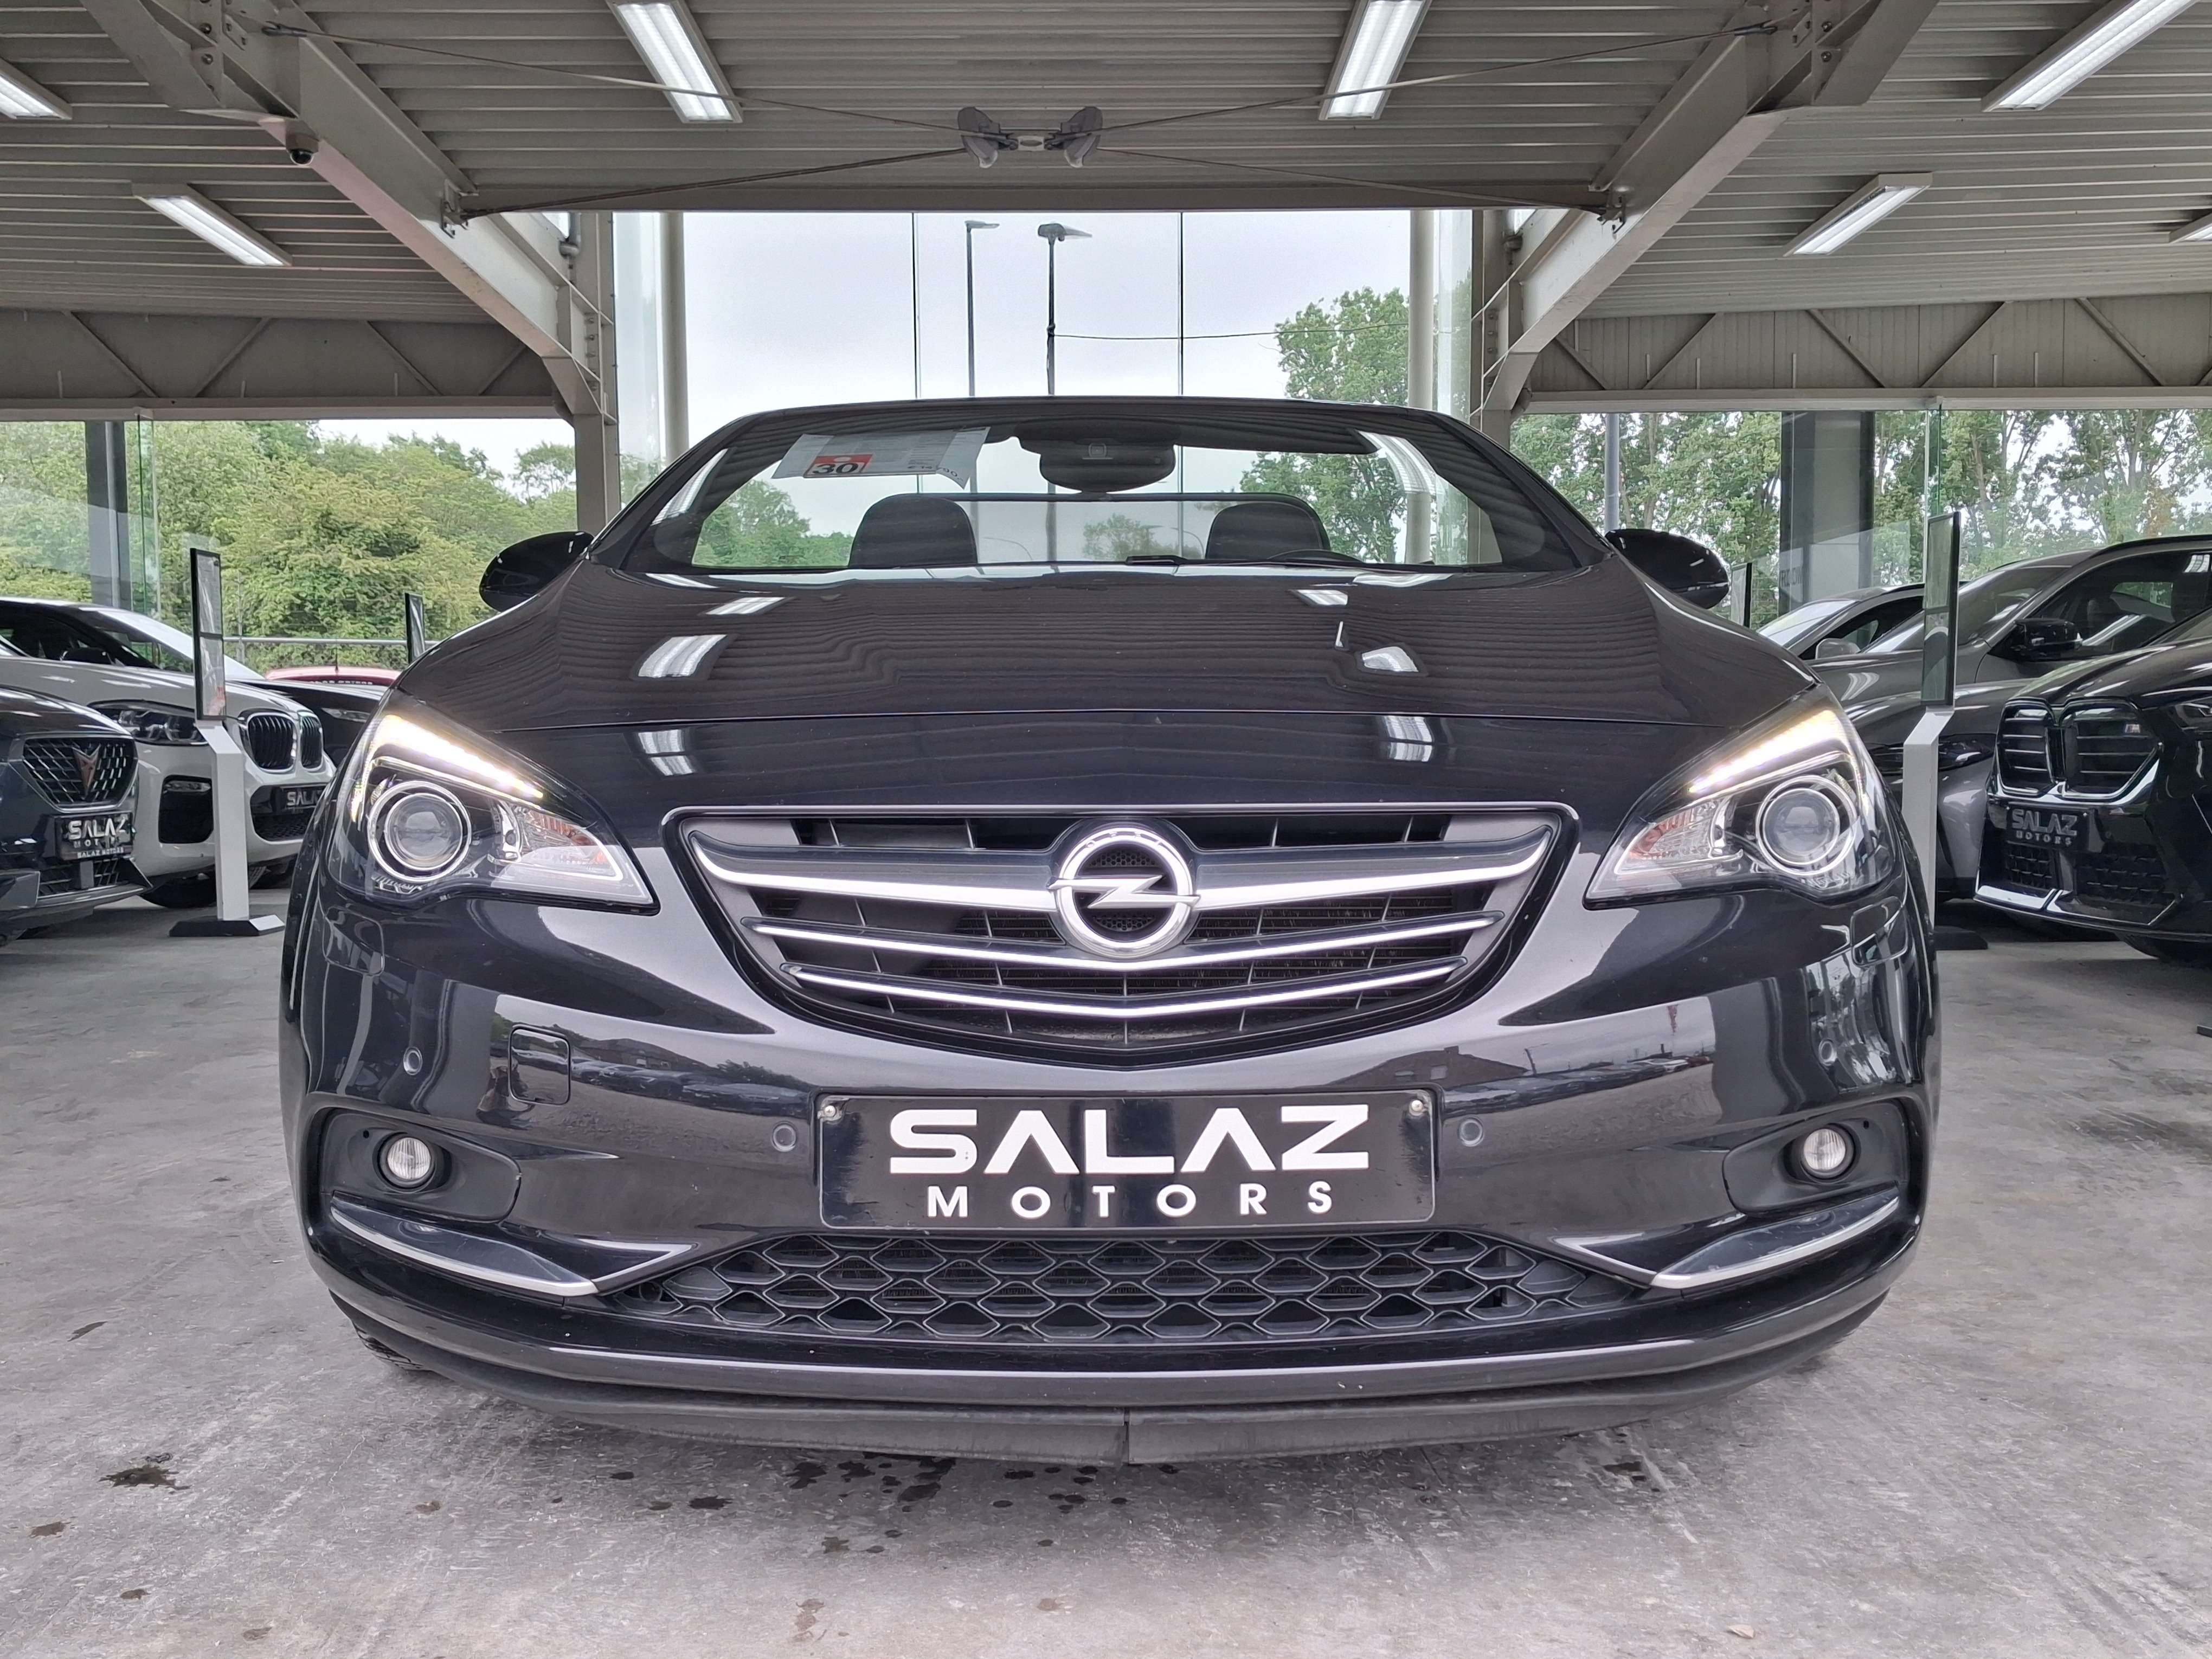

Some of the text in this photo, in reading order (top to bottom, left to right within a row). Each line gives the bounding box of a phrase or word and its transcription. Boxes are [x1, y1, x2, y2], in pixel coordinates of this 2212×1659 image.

[813, 463, 858, 473] 30
[2012, 808, 2078, 837] SALAZ
[890, 1104, 1369, 1174] SALAZ
[928, 1180, 1333, 1219] MOTORS
